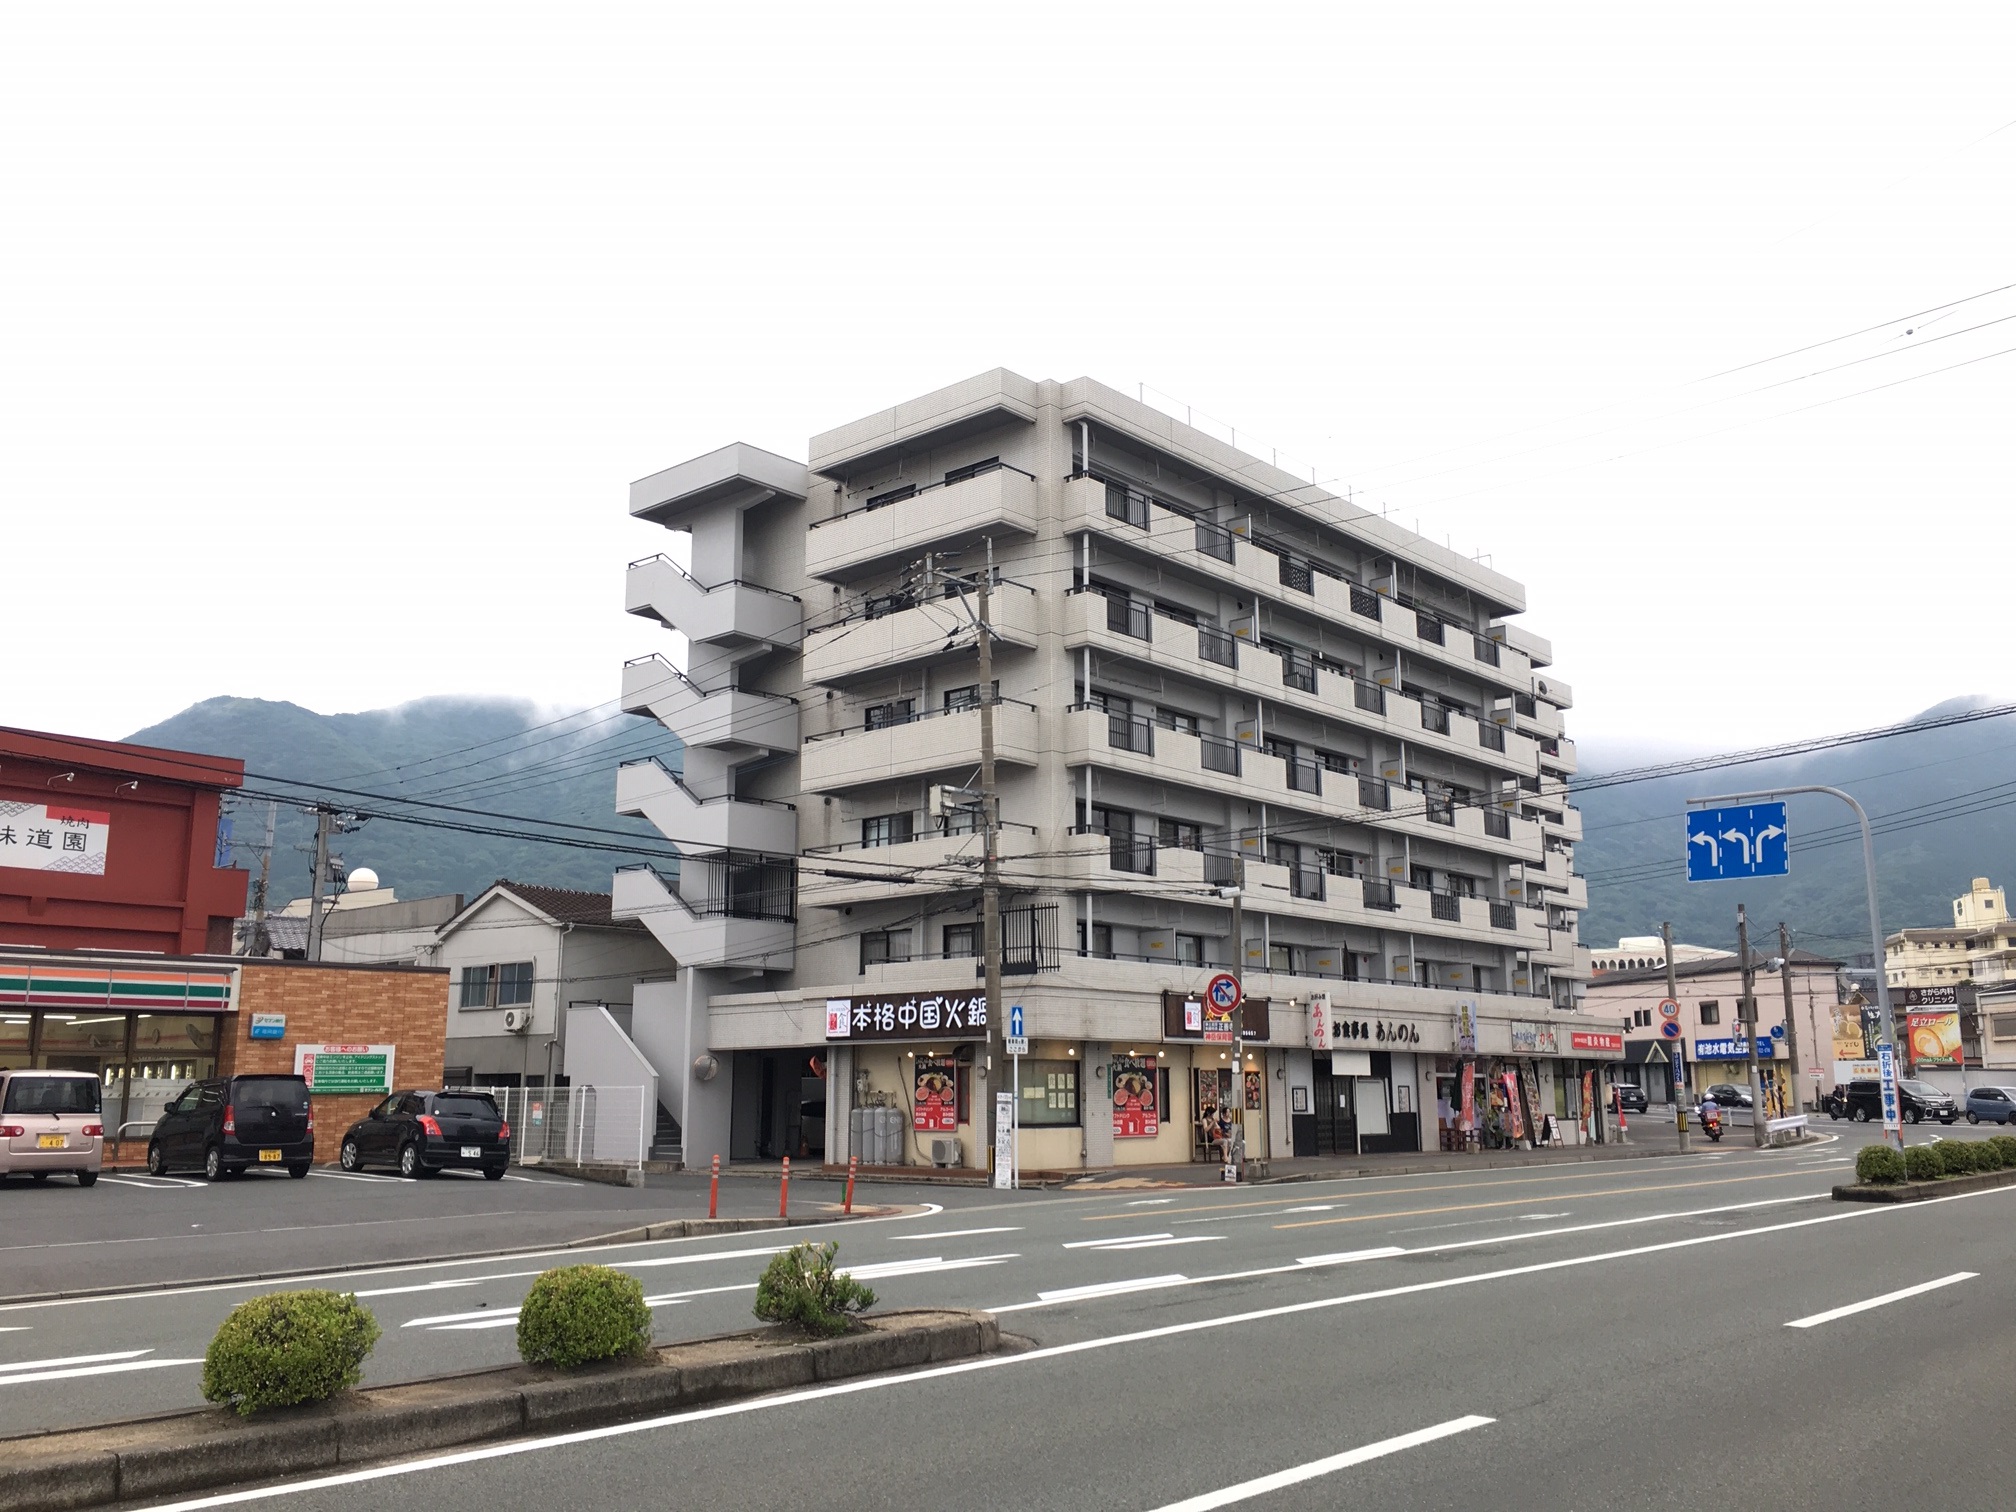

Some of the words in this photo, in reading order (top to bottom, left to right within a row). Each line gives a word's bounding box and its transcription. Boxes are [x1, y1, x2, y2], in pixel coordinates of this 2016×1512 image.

[60, 815, 89, 829] 焼肉
[1921, 987, 1954, 996] さがら内科
[1921, 996, 1955, 1004] クリニック
[1663, 1004, 1676, 1013] 40
[1312, 1003, 1326, 1048] あんのん
[1911, 1018, 1954, 1027] 足立ロール
[1376, 1020, 1419, 1044] あんのん
